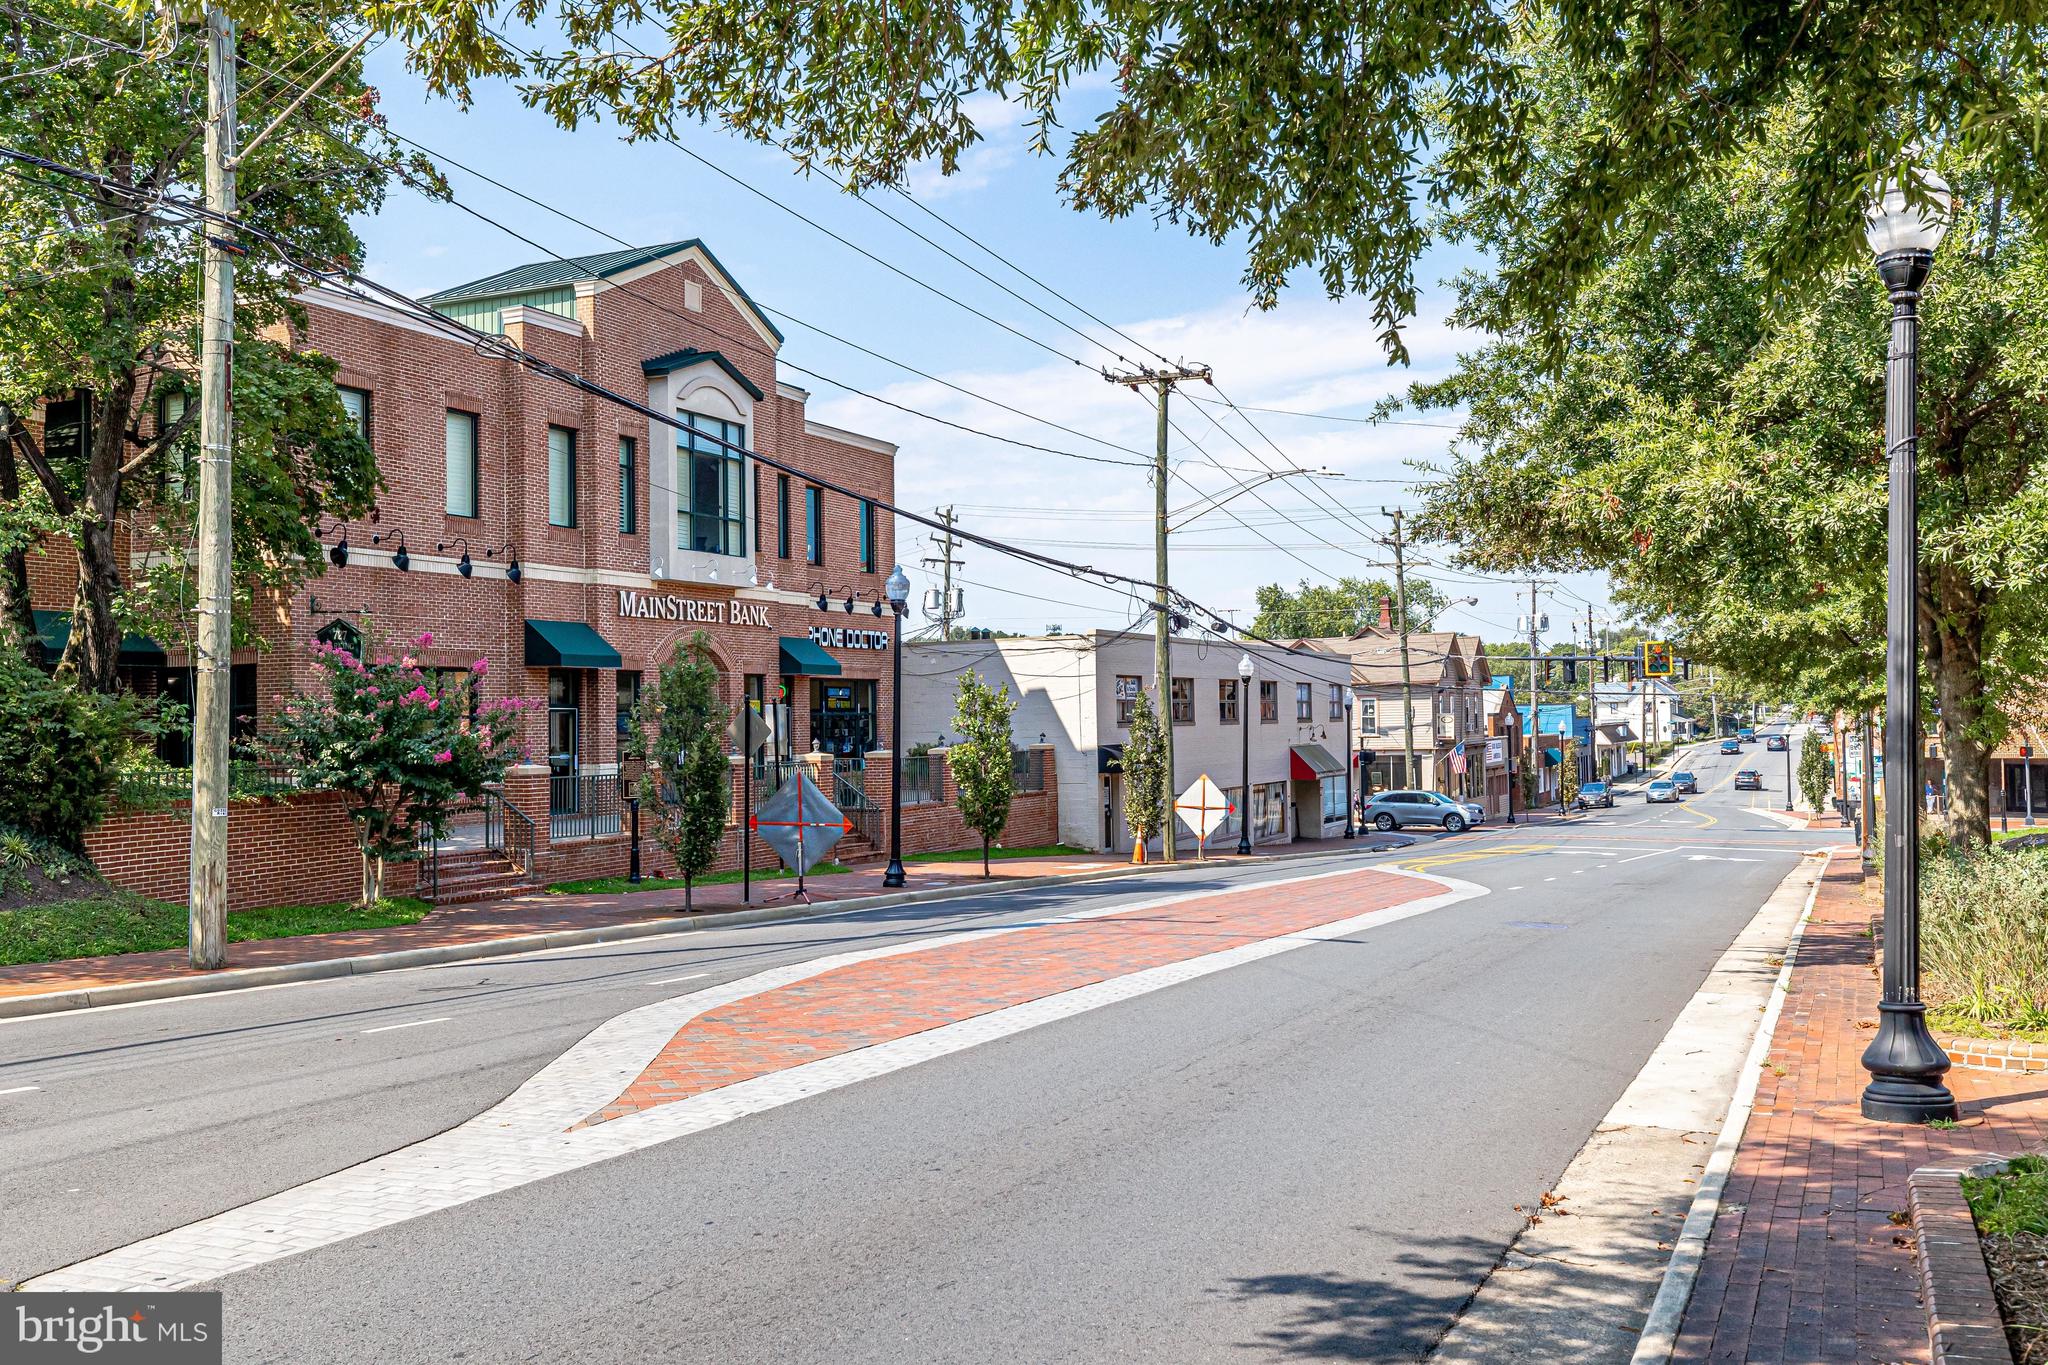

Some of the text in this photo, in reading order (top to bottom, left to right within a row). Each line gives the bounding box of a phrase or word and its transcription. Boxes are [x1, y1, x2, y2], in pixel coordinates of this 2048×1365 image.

[619, 590, 769, 627] MAINSTREET BANK
[808, 626, 888, 650] PHONE DOCTOR
